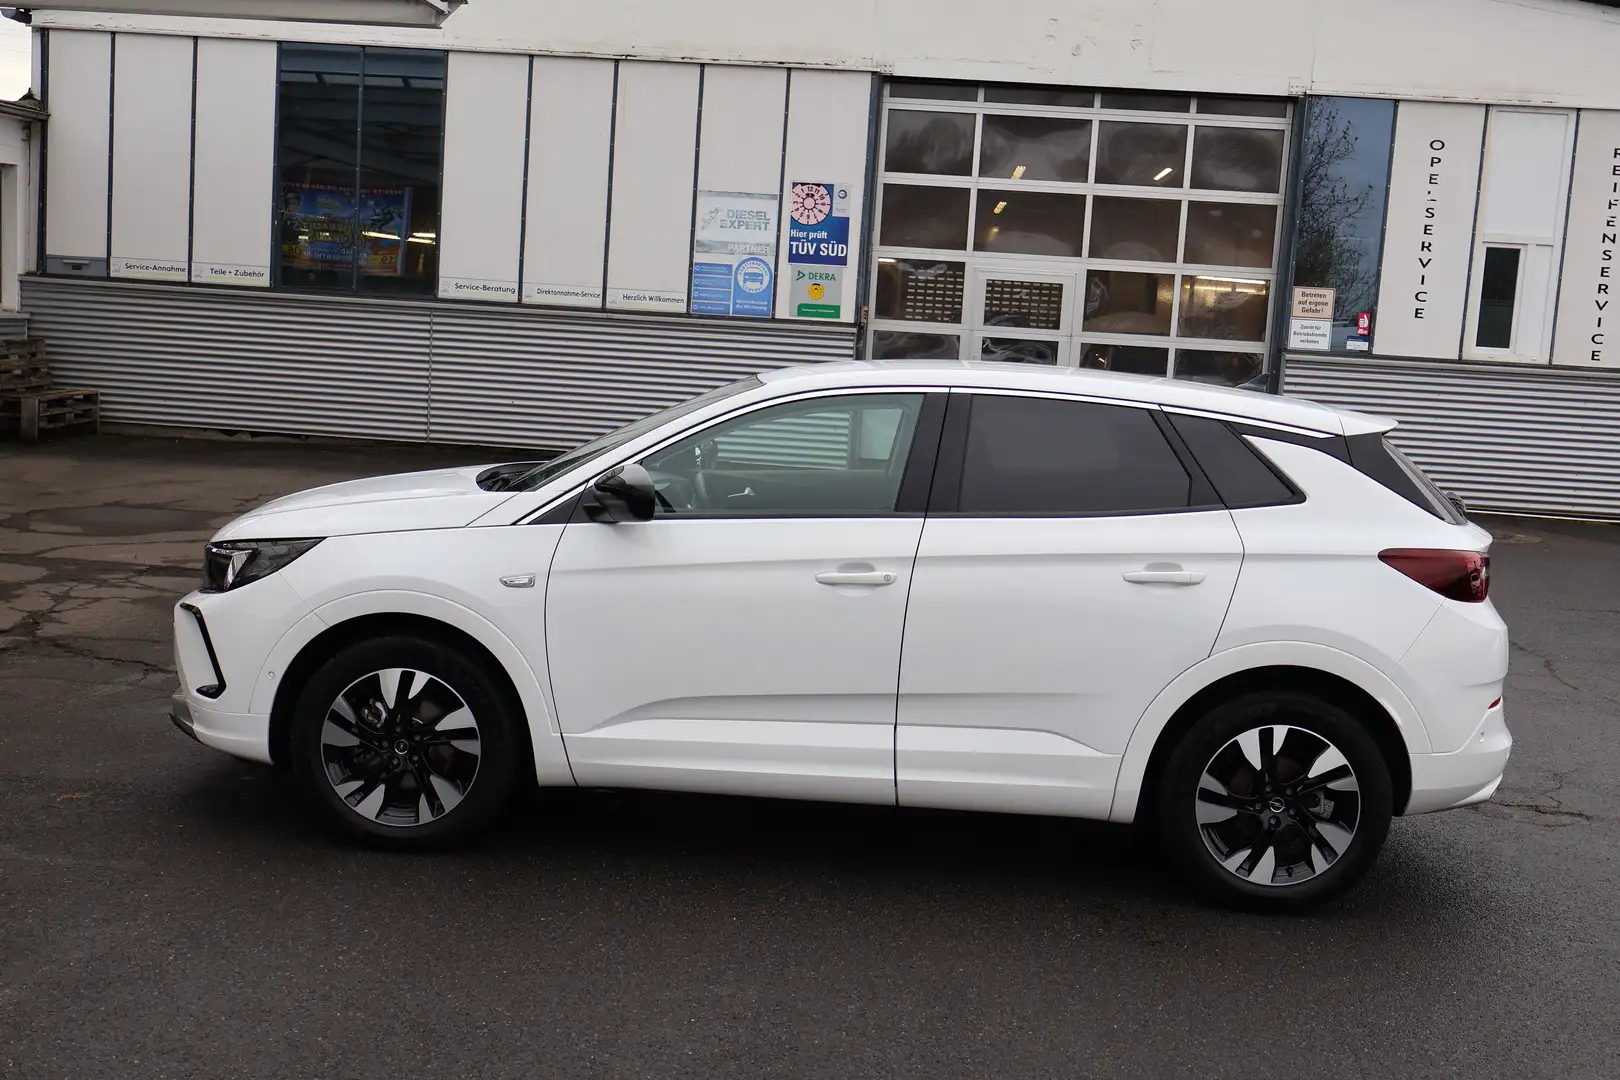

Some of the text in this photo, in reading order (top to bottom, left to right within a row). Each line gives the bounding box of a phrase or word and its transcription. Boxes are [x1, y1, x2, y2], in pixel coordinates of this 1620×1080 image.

[719, 219, 770, 231] EXPERT
[790, 229, 828, 240] Hier prüft
[728, 244, 769, 253] PARTNER
[790, 239, 847, 257] TÜV SÜD
[1590, 148, 1620, 361] REIFENSERVICE
[124, 262, 186, 273] Service-Annahme
[210, 268, 226, 276] Teile
[234, 270, 265, 278] Zubehör
[808, 272, 836, 281] DEKRA
[454, 282, 516, 294] Service-Beratung
[536, 288, 601, 299] Direktannahme-Service
[622, 294, 647, 302] Herzlich
[648, 295, 684, 304] Willkommen
